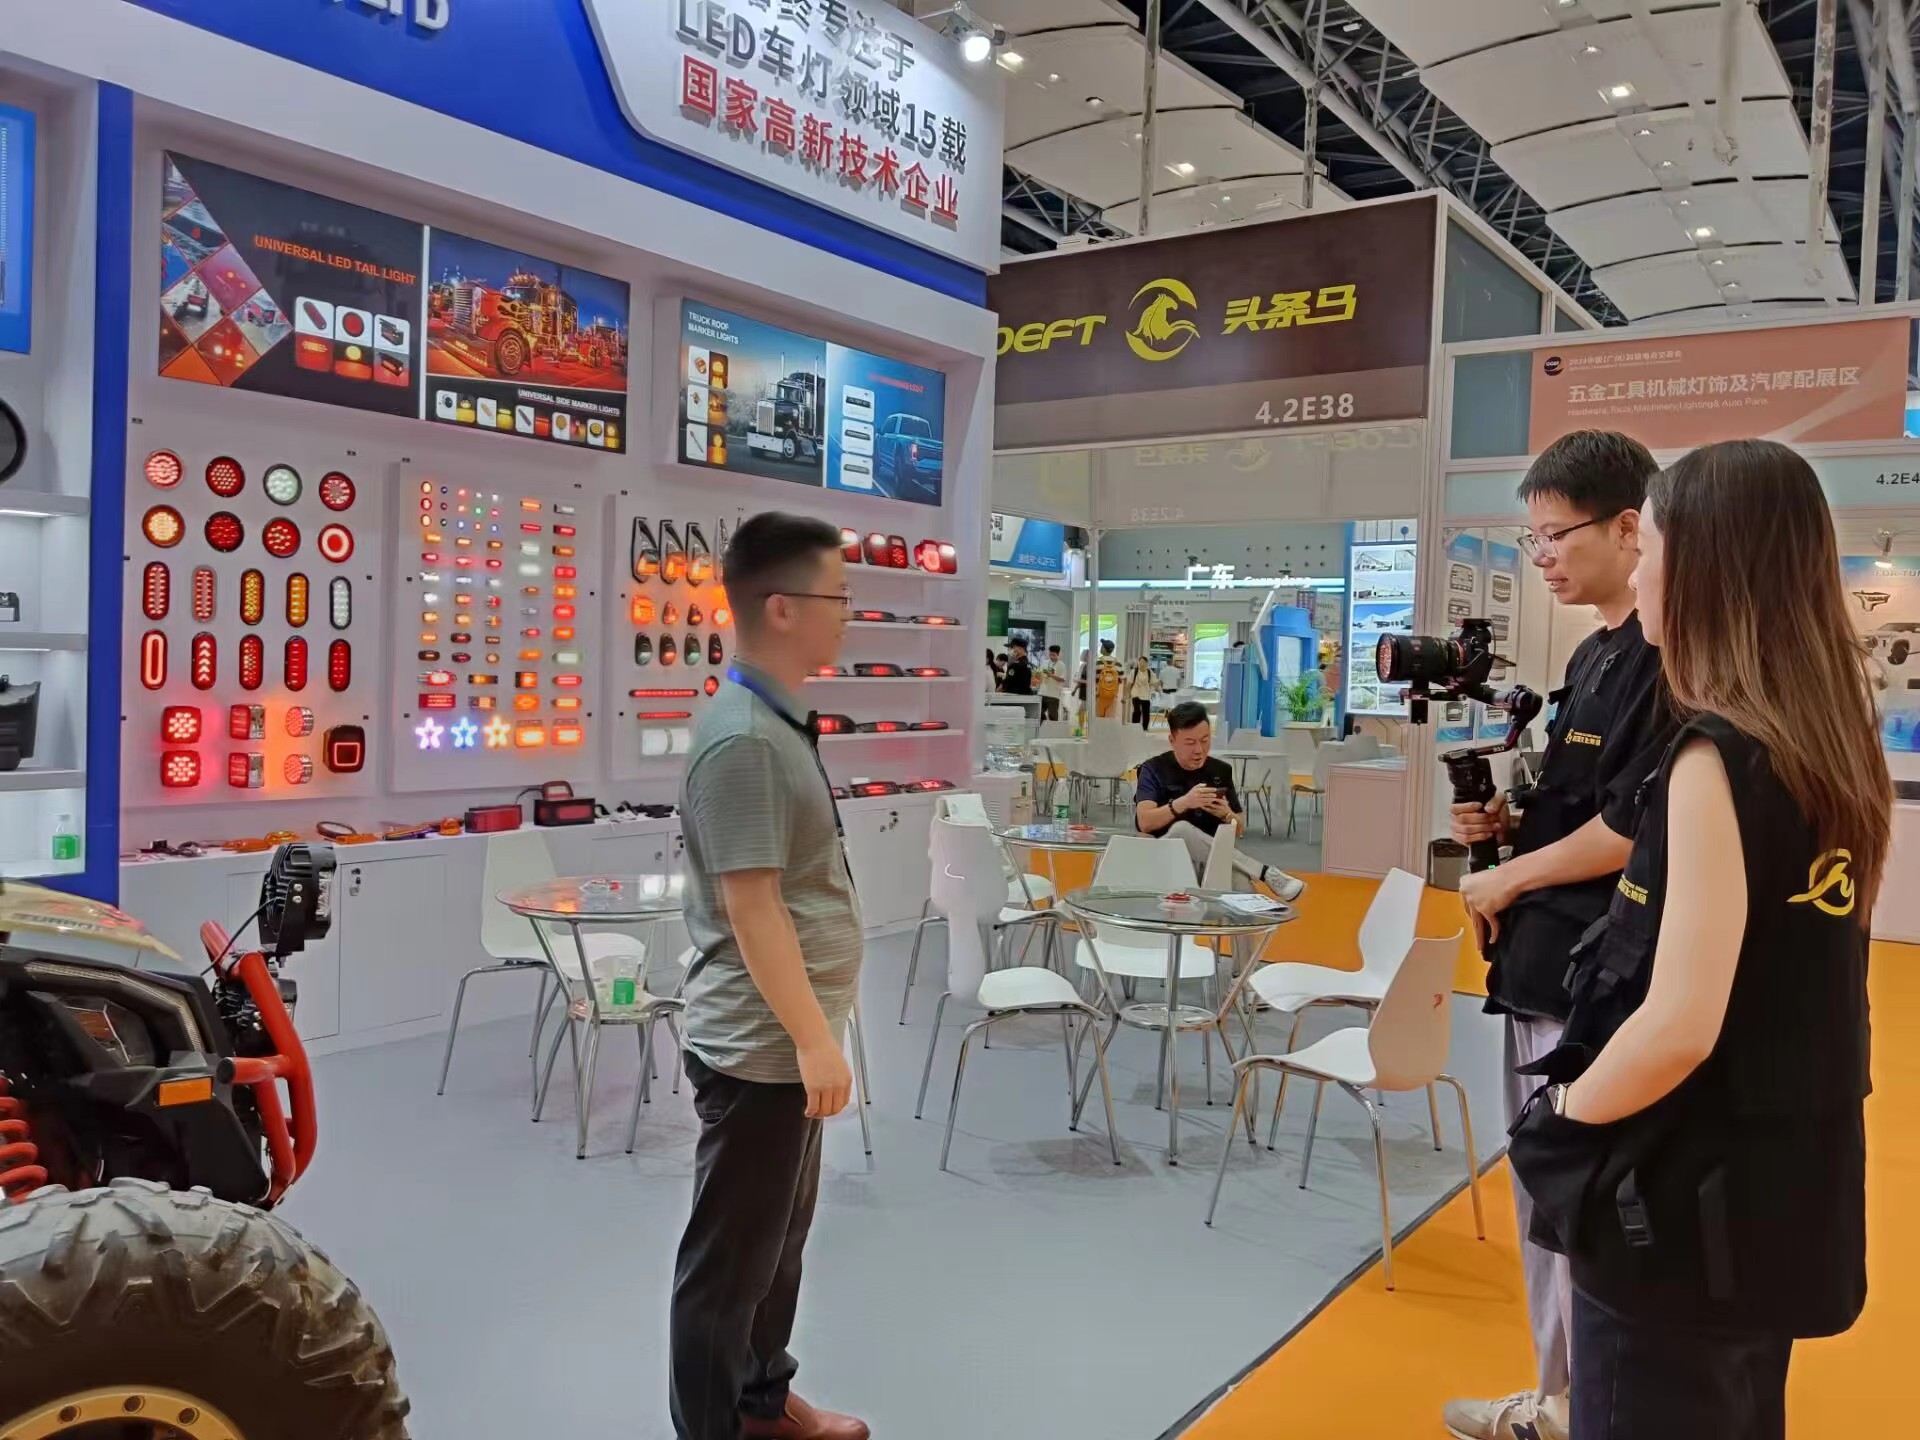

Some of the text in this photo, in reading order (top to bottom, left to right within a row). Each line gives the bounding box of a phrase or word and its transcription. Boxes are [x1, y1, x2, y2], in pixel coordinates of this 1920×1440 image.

[683, 54, 959, 221] 国家高新技术企业
[255, 234, 416, 285] UNIVERSAL LED TAIL LIGHT
[689, 311, 729, 330] TRUCK ROOF
[1221, 284, 1357, 335] 头条马
[688, 322, 739, 344] MARKER LIGHTS
[1568, 367, 1860, 403] 五金工具机械灯饰及汽摩配展区
[518, 389, 620, 416] UNIVERSAL SIDE MARKER LIGHTS
[1255, 393, 1354, 424] 4.2E38
[1186, 563, 1235, 590] 广东
